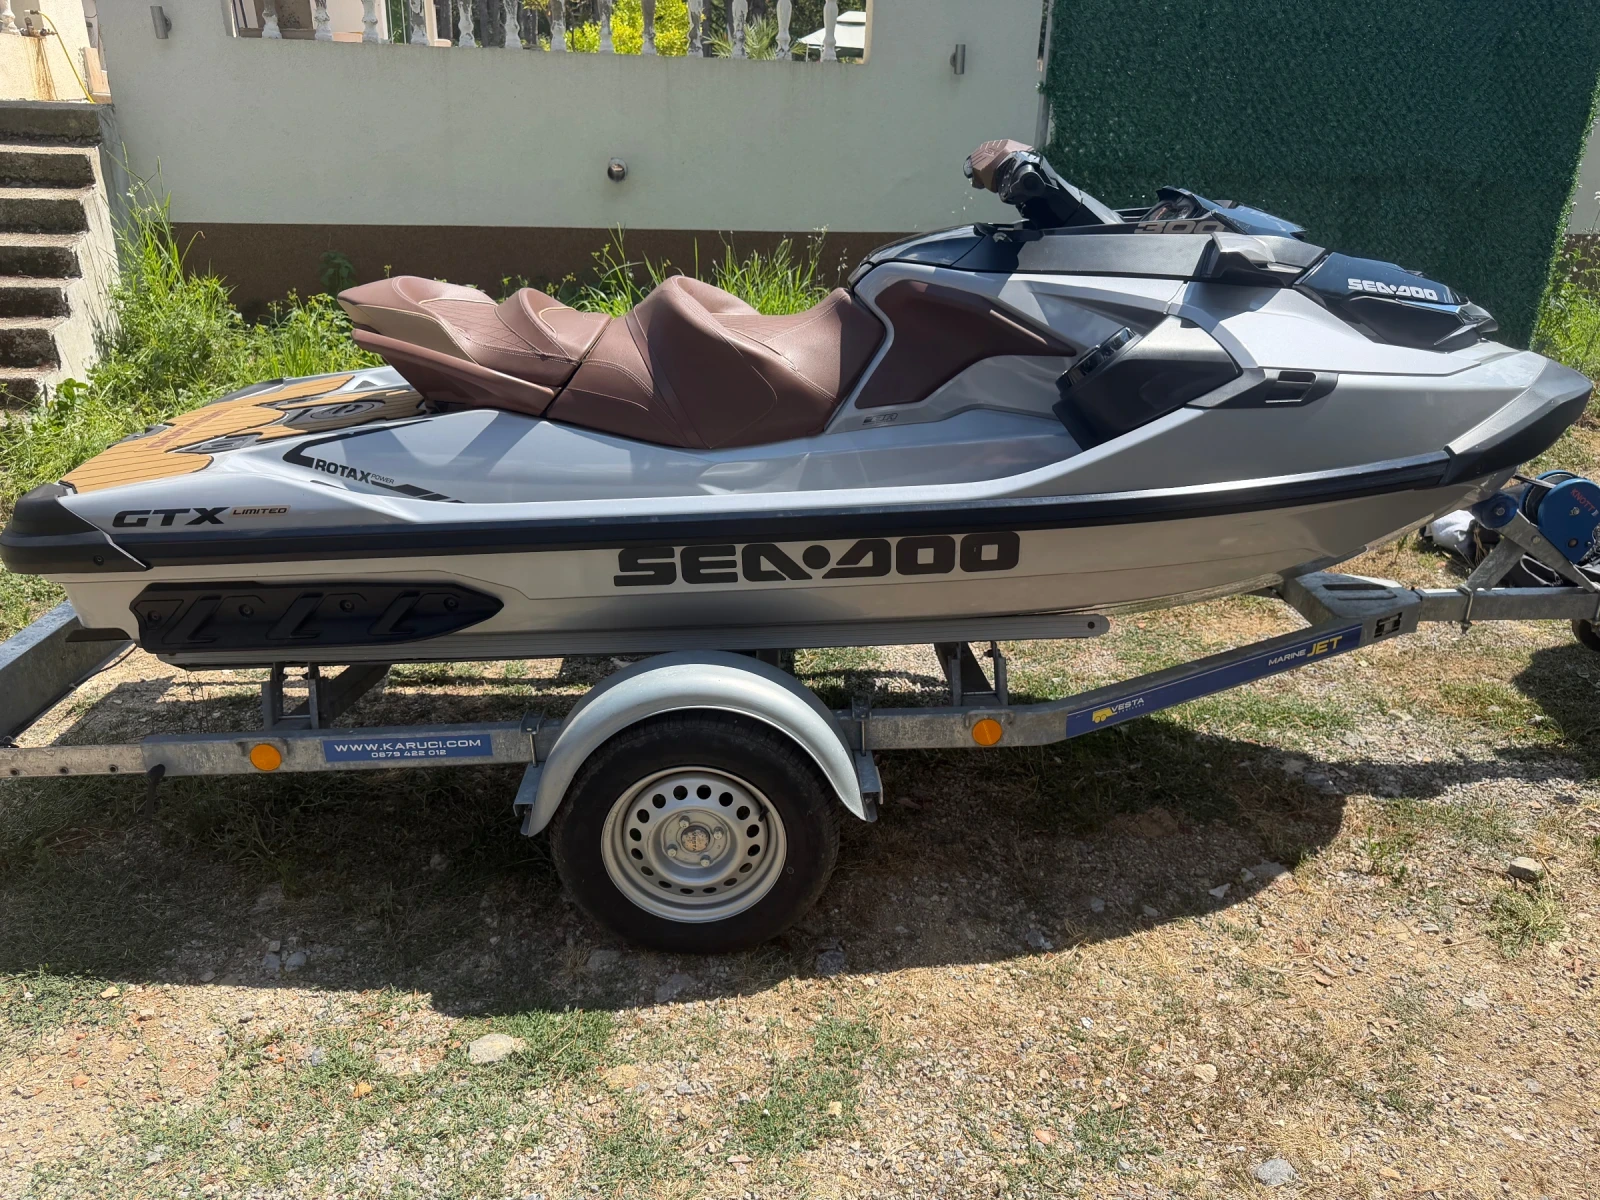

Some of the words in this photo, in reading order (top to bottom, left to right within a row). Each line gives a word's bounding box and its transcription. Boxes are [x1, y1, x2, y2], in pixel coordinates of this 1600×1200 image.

[1134, 220, 1225, 234] 300
[314, 458, 371, 484] ROTAX
[371, 473, 395, 485] POWER
[1571, 488, 1596, 512] KNOTT
[112, 507, 230, 528] GTX
[232, 507, 288, 516] LIMITED
[1268, 648, 1307, 667] MARINE
[1307, 635, 1343, 657] JET
[1111, 697, 1145, 713] VESTA
[334, 739, 481, 752] WWW.KARUCI.COM
